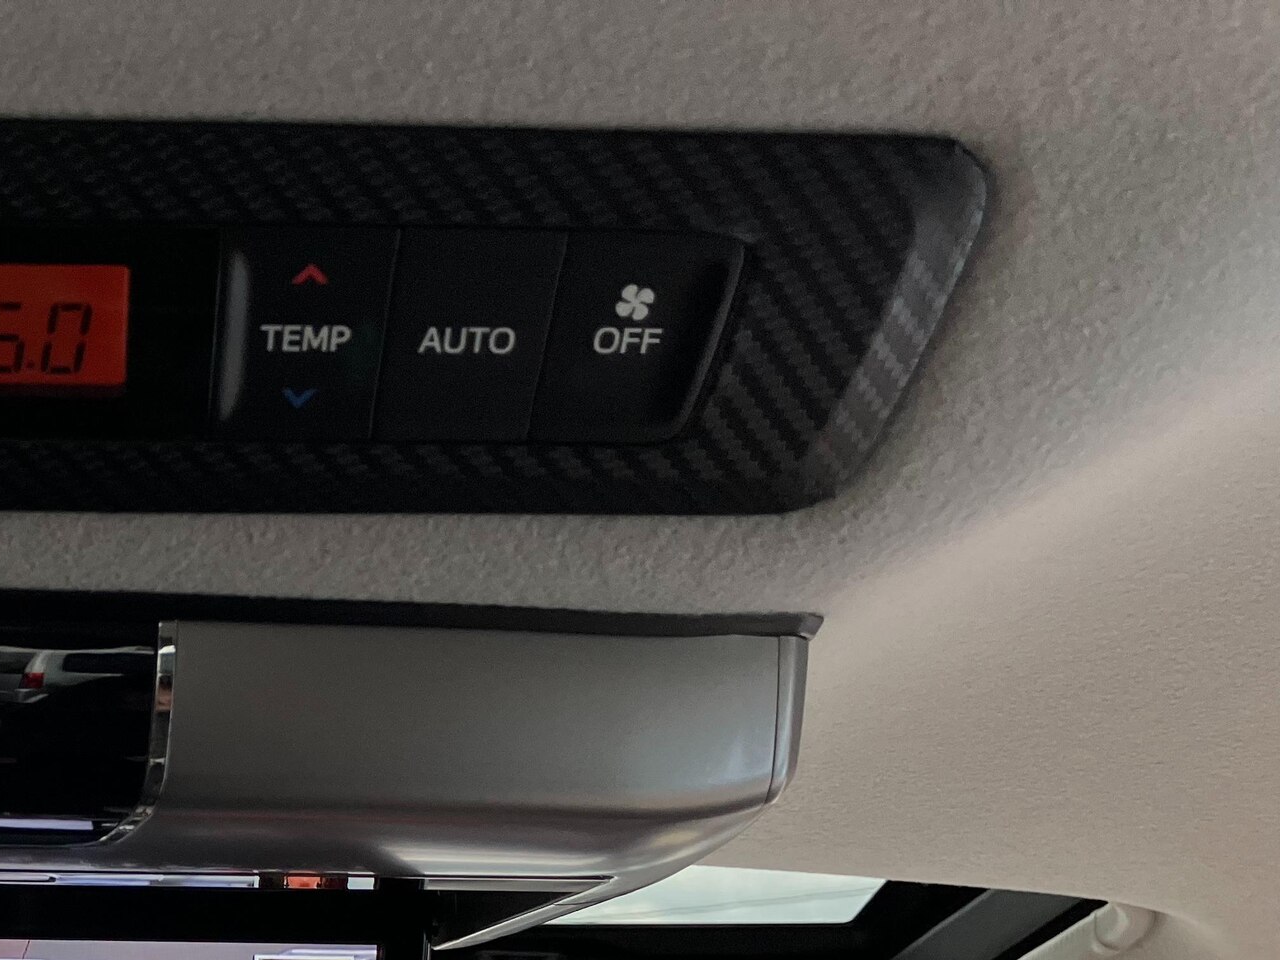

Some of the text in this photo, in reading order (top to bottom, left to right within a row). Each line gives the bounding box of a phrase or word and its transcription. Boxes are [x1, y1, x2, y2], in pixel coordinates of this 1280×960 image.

[260, 323, 352, 353] TEMP
[418, 326, 516, 355] AUTO
[592, 326, 663, 355] OFF
